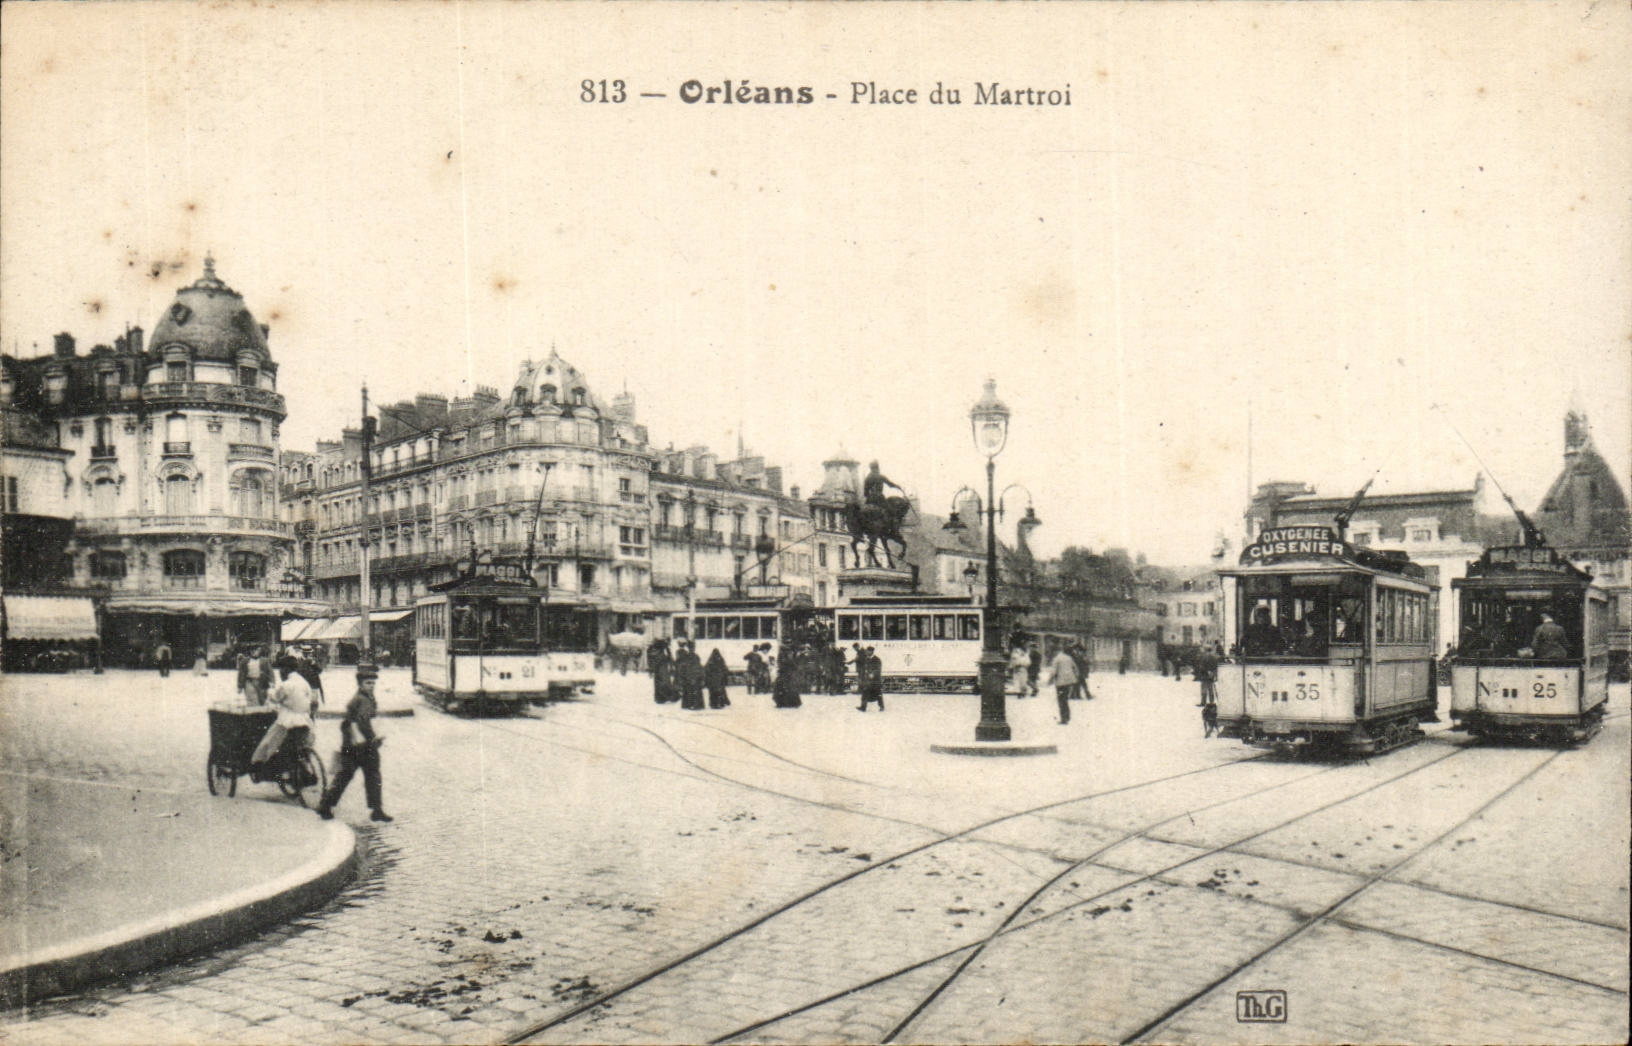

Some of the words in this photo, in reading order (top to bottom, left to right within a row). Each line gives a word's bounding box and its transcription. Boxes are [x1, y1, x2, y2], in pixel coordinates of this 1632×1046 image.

[1249, 541, 1344, 558] CUSENIER
[521, 665, 535, 678] 21
[1295, 683, 1320, 701] 35
[1533, 682, 1557, 698] 25
